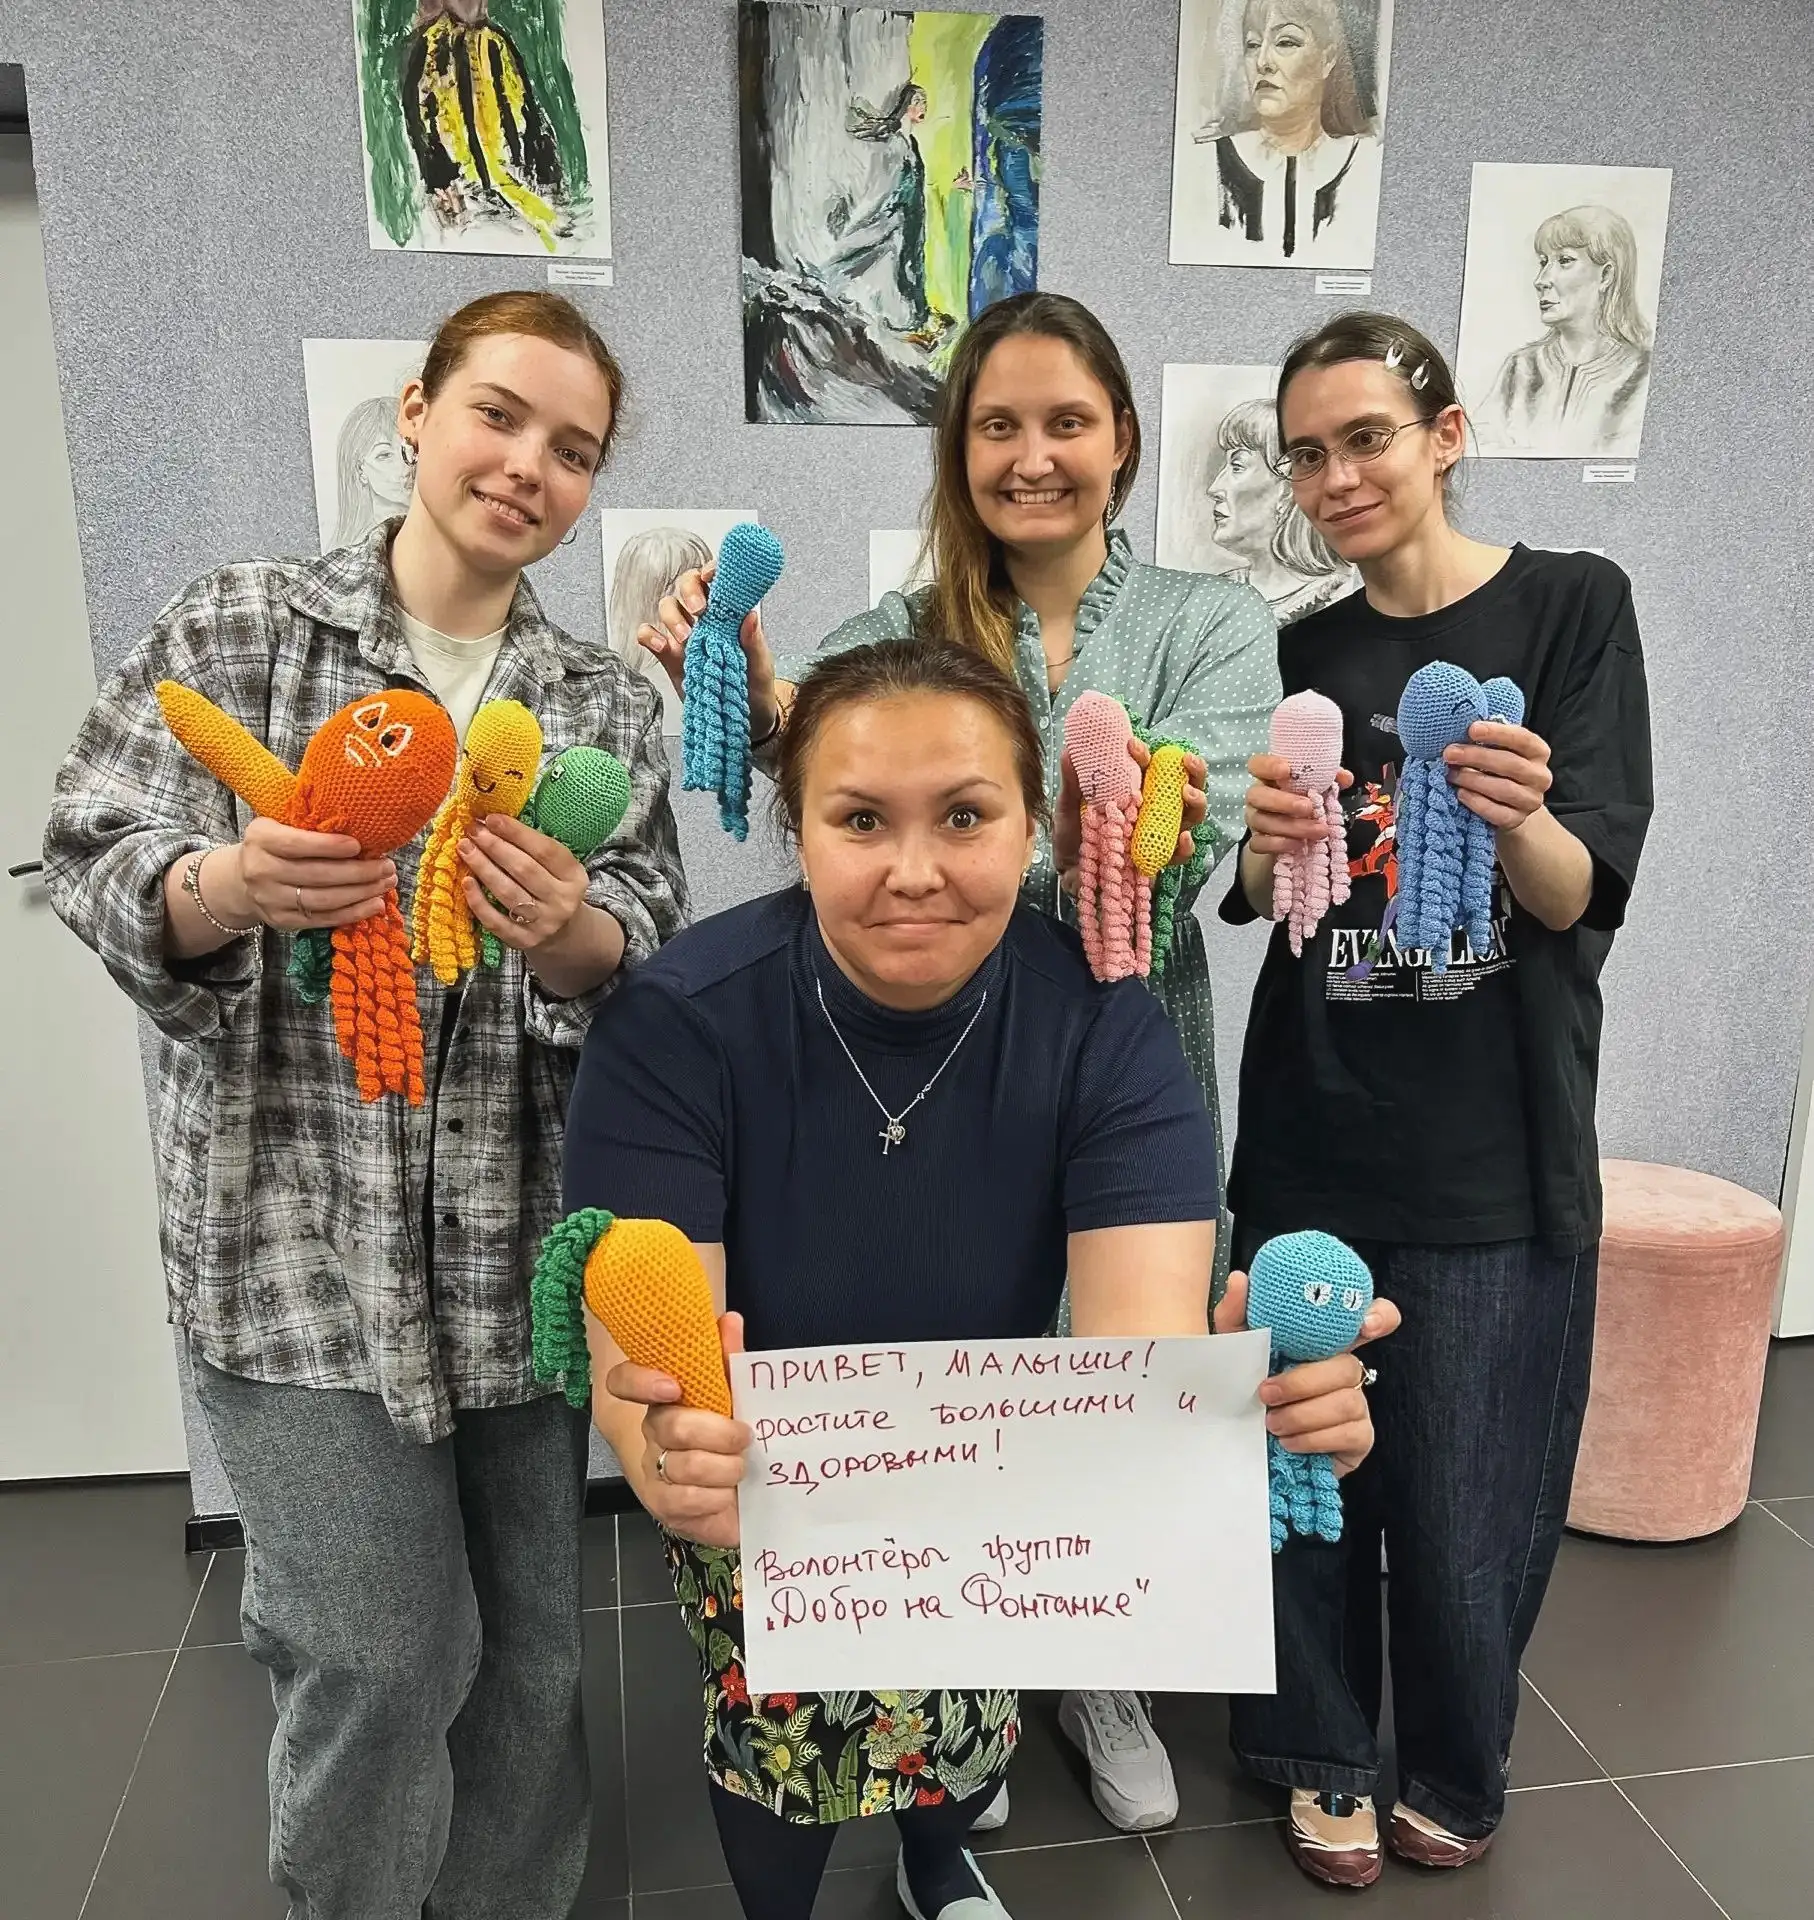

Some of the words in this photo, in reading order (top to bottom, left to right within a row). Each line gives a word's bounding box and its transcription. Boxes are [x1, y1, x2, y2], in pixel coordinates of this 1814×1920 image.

[750, 1350, 924, 1390] ПРИВЕТ,
[945, 1340, 1156, 1379] МАЛЫШИ!
[756, 1410, 897, 1454] растите
[1178, 1391, 1197, 1414] и
[754, 1537, 950, 1587] Волонтёры
[982, 1534, 1091, 1577] группы
[904, 1595, 954, 1619] на
